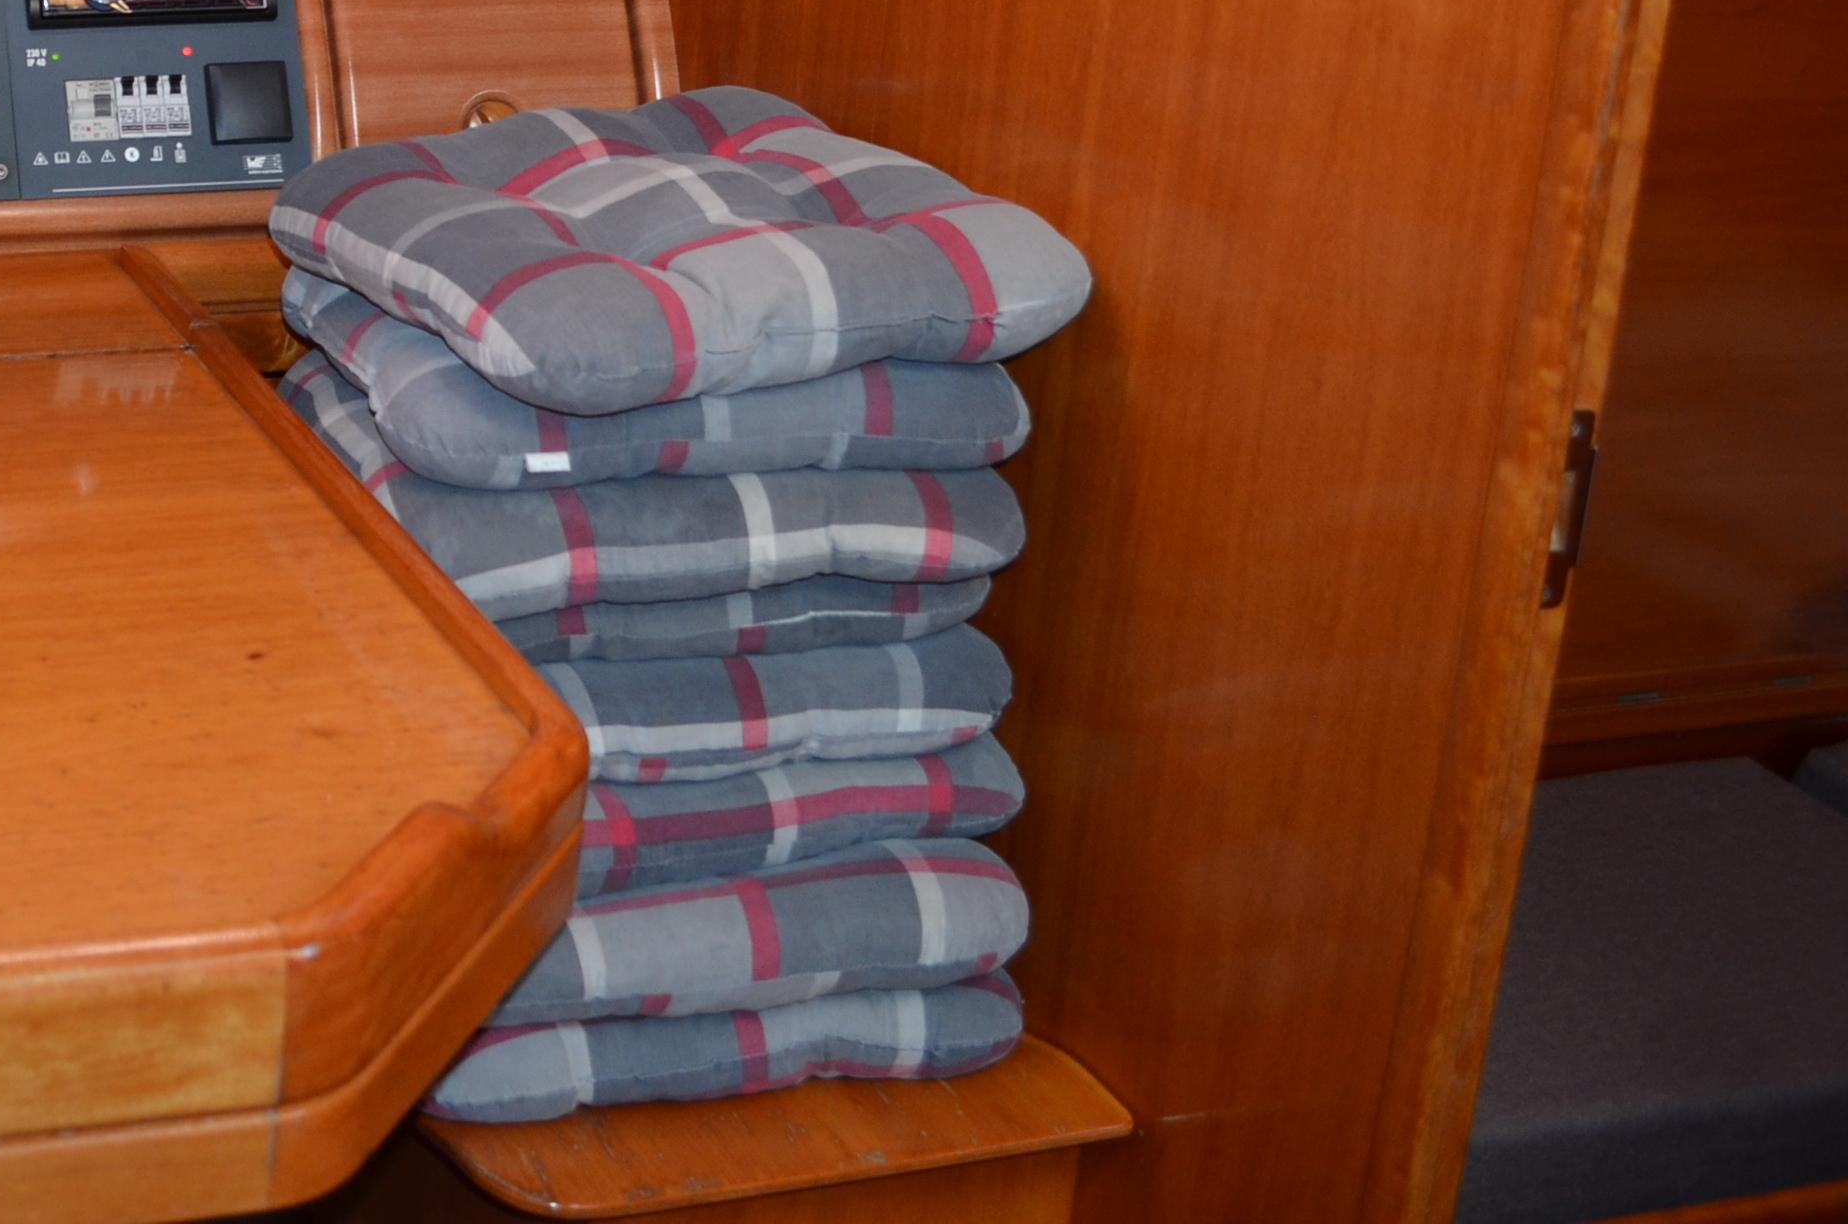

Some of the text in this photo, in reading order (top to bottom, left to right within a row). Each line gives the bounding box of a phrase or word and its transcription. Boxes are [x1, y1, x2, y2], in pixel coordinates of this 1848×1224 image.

[25, 47, 47, 57] 230 V
[26, 58, 34, 67] IP
